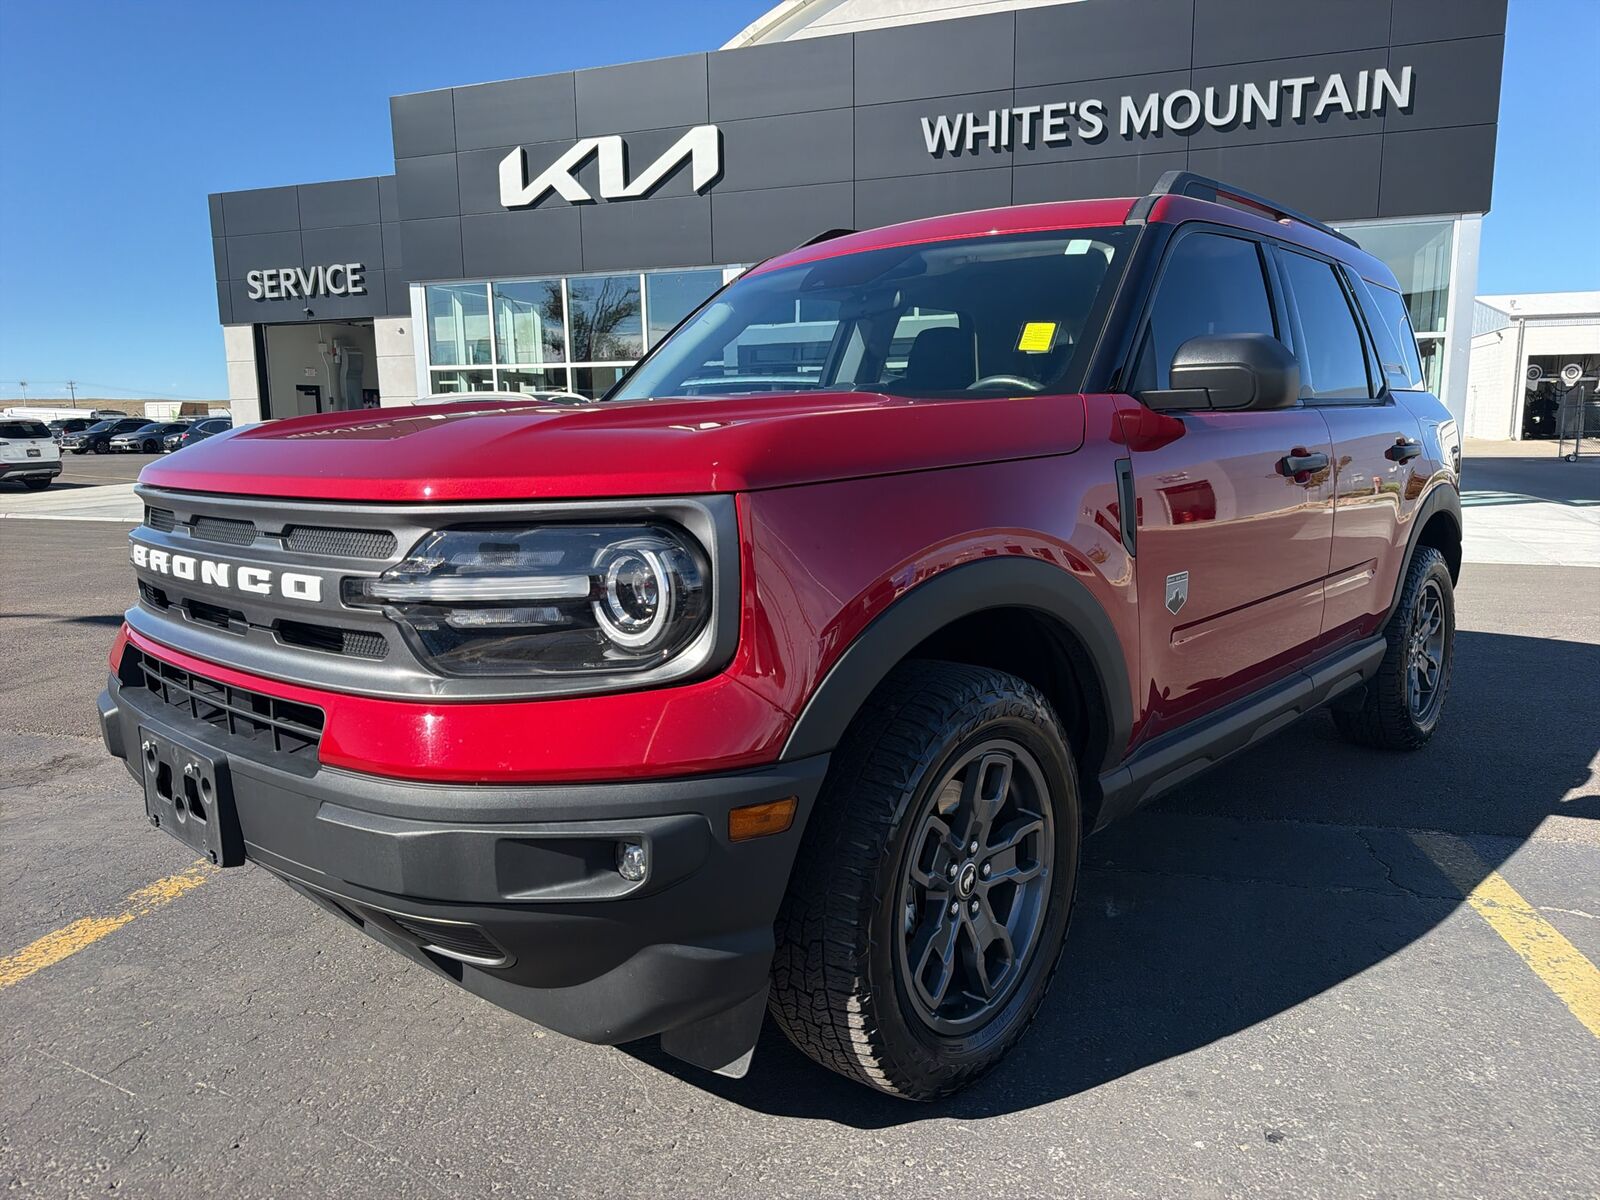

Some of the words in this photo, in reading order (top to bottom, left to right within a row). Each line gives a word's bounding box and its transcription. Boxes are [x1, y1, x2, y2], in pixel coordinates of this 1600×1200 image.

[920, 99, 1104, 154] WHITE'S
[1119, 65, 1413, 136] MOUNTAIN
[498, 124, 719, 208] KIA
[246, 262, 363, 300] SERVICE
[132, 543, 325, 602] BRONCO
